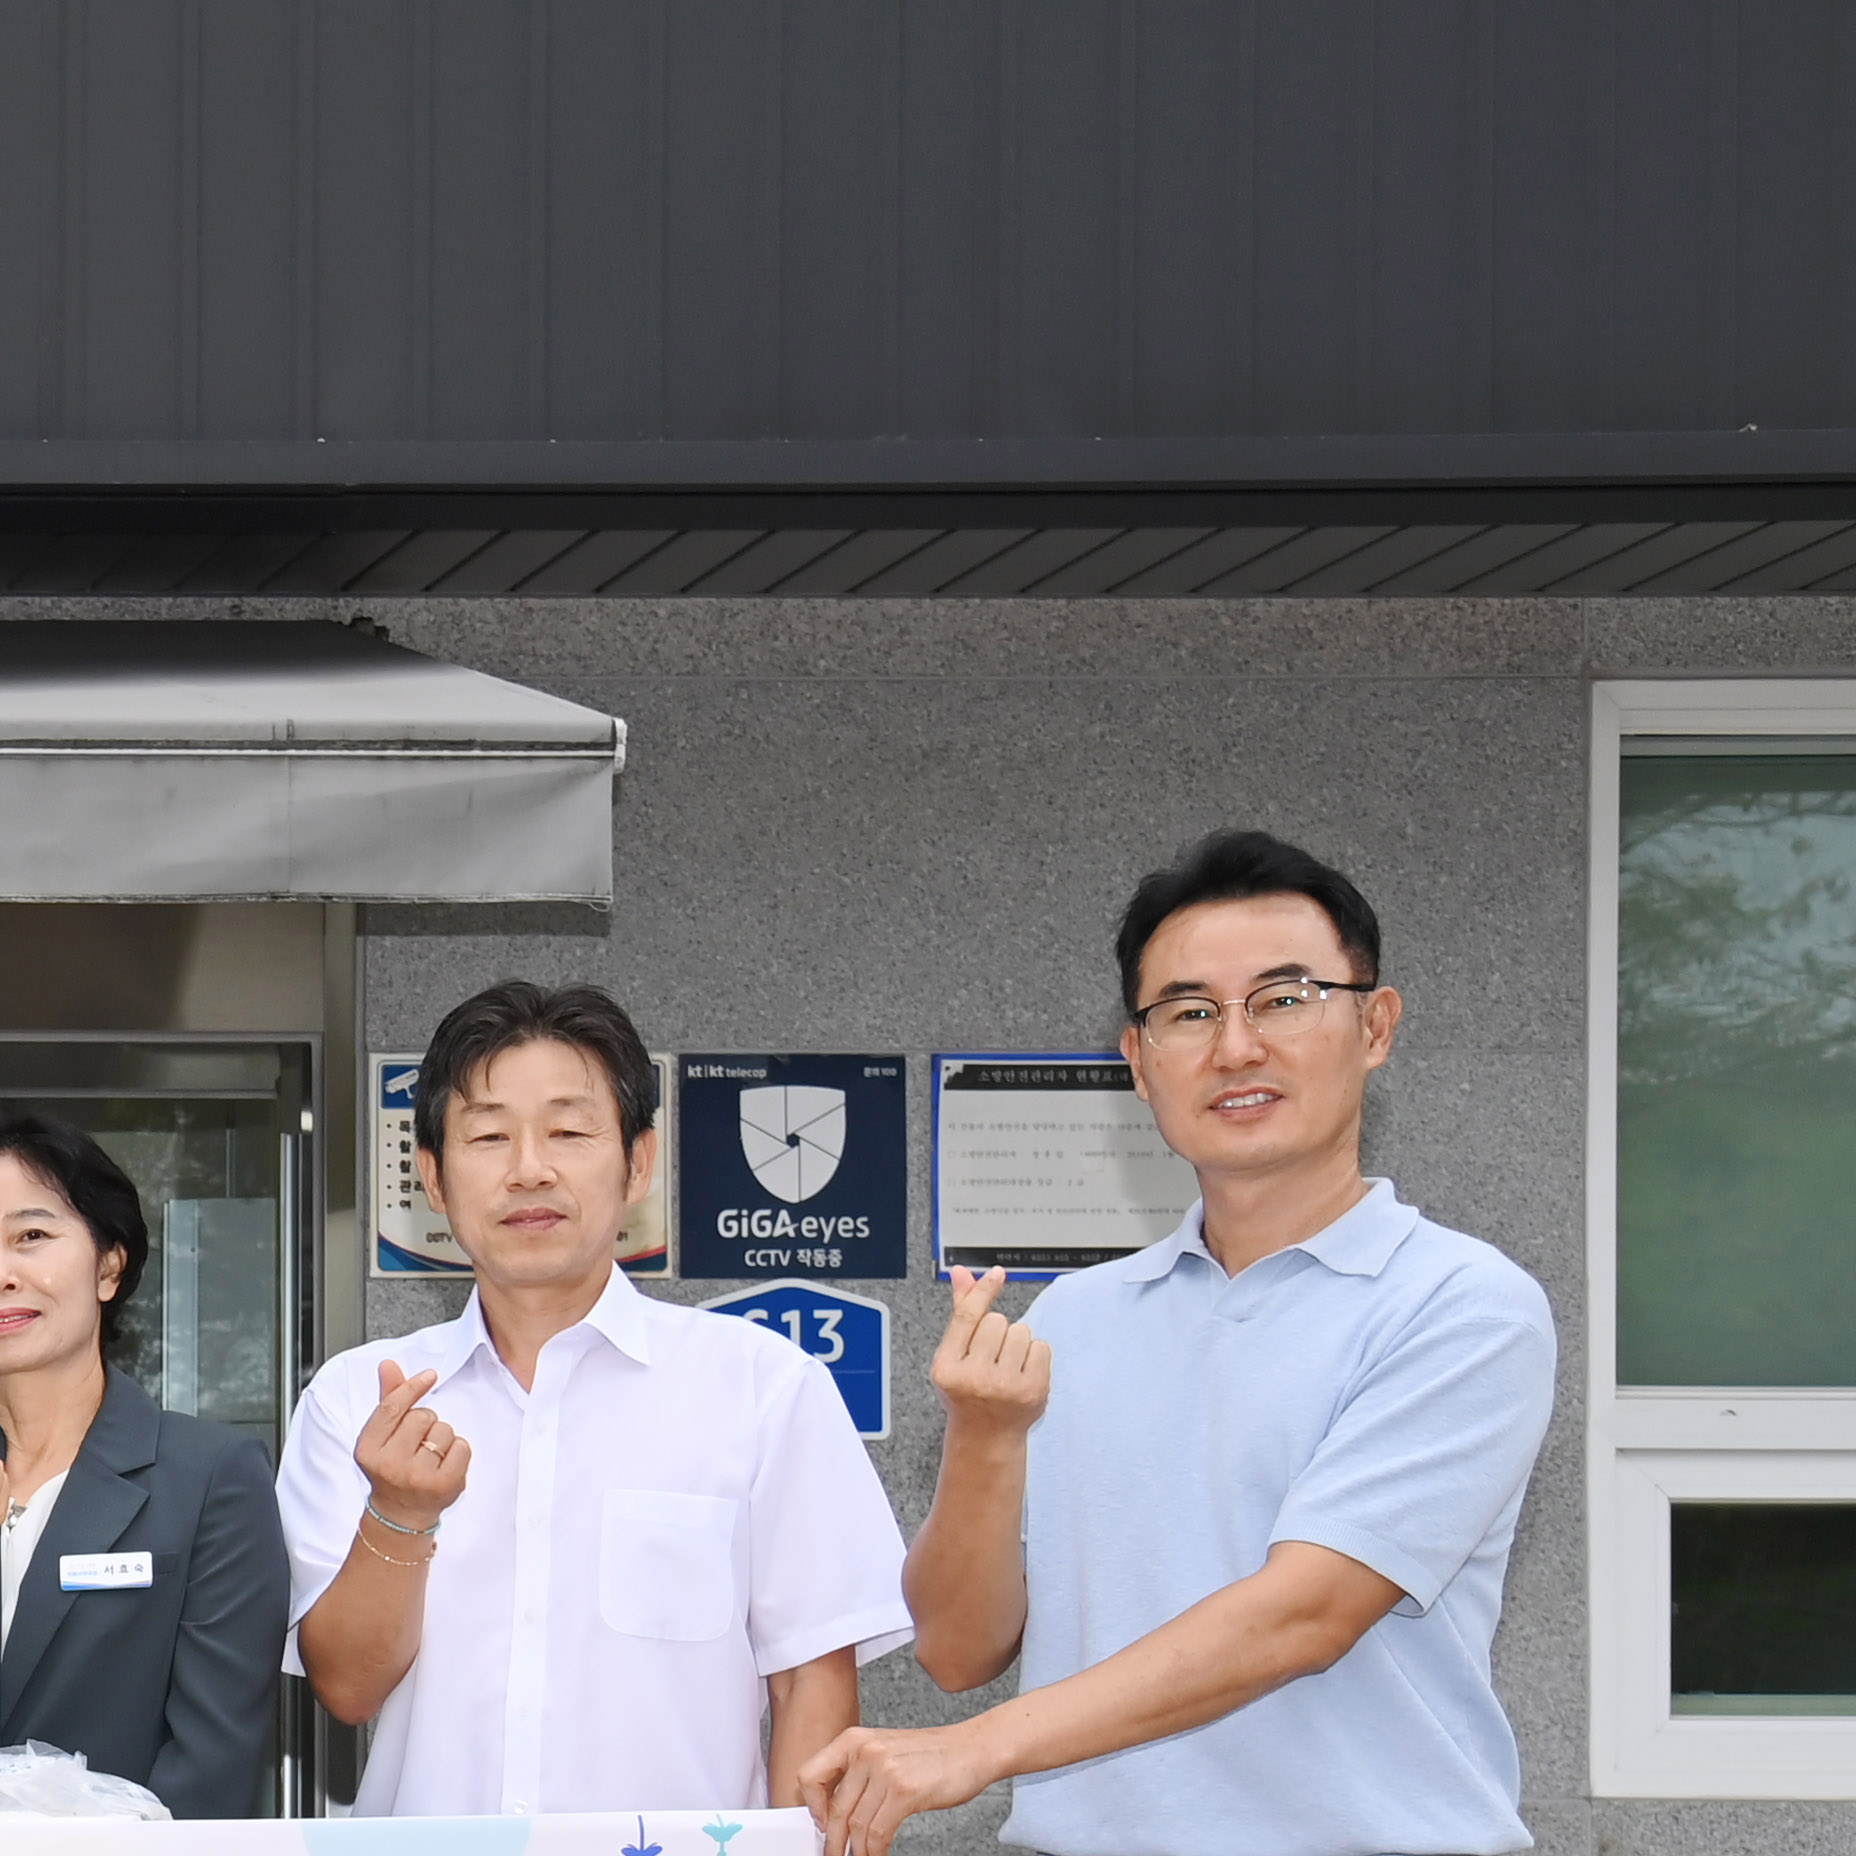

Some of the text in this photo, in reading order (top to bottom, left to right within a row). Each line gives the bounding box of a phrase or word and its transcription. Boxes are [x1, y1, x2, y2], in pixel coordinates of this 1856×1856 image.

[688, 1065, 767, 1079] kt kt telecop
[745, 1248, 843, 1268] CCTV 작동중
[743, 1308, 845, 1363] 13
